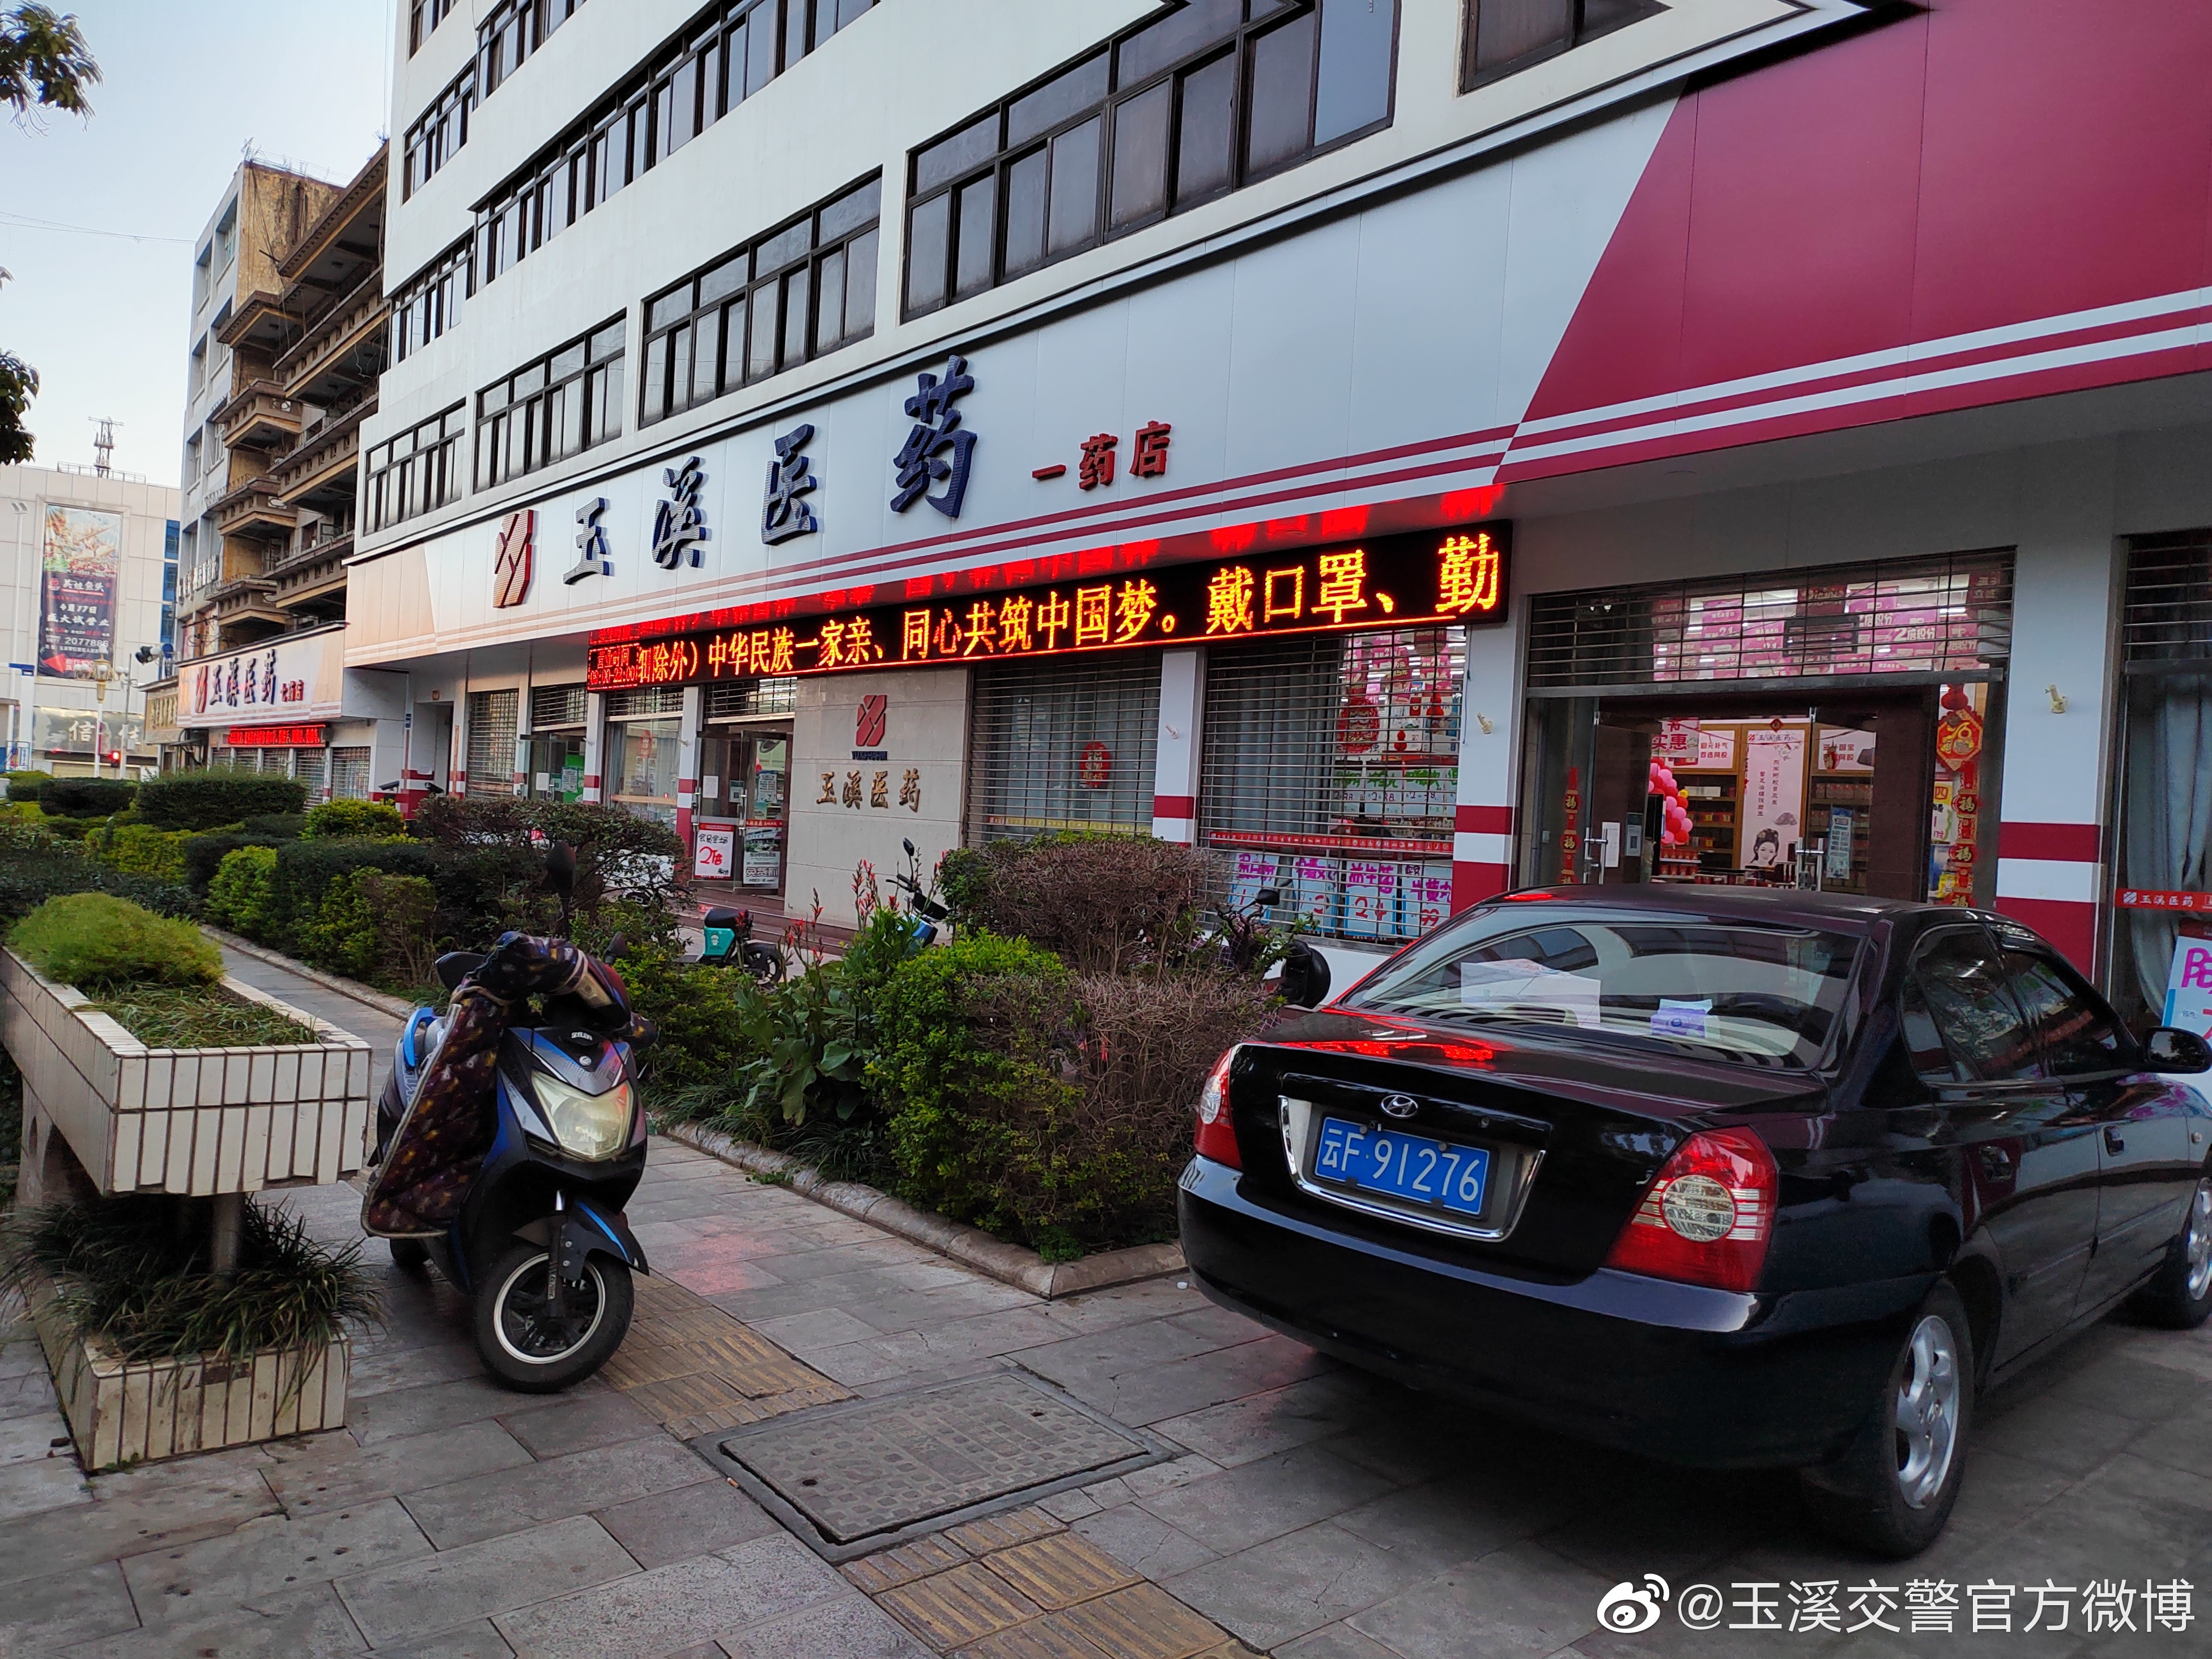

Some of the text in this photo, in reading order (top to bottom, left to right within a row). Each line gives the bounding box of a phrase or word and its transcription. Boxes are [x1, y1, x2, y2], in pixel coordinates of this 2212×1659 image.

[1032, 420, 1171, 491] 一药店
[563, 354, 978, 585] 玉溪医药
[210, 649, 276, 707] 玉溪医药
[816, 768, 921, 813] 玉溪医药
[1566, 796, 1576, 809] 福
[1959, 796, 1975, 812] 福
[699, 833, 729, 845] 会员全场
[1564, 837, 1575, 849] 福
[1956, 846, 1972, 862] 福
[2139, 895, 2193, 907] 玉溪医药
